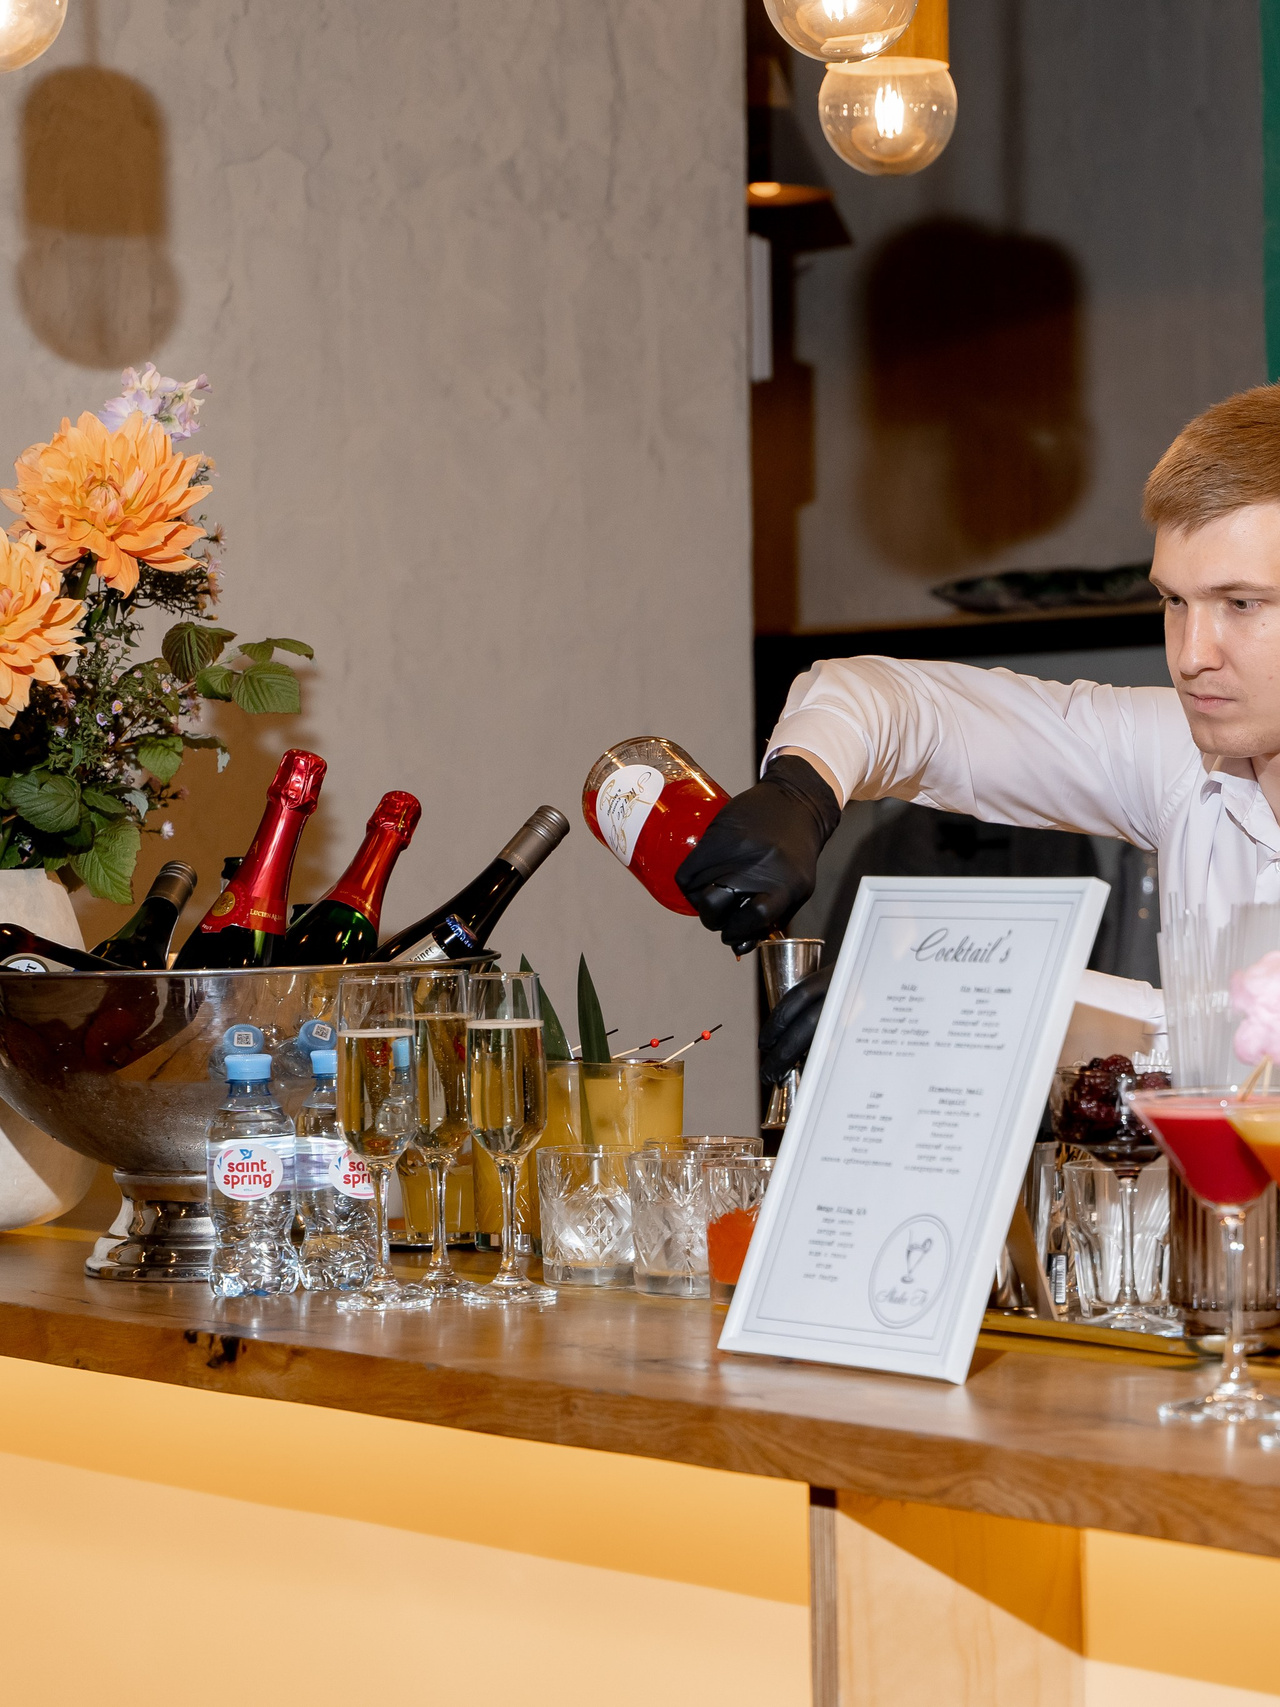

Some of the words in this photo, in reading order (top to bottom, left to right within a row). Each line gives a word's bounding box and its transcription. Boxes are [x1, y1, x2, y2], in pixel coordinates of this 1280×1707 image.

[910, 926, 1012, 964] Cocktail's
[227, 1159, 267, 1173] saint
[348, 1160, 368, 1173] sa
[223, 1173, 272, 1189] spring
[342, 1174, 371, 1189] spri
